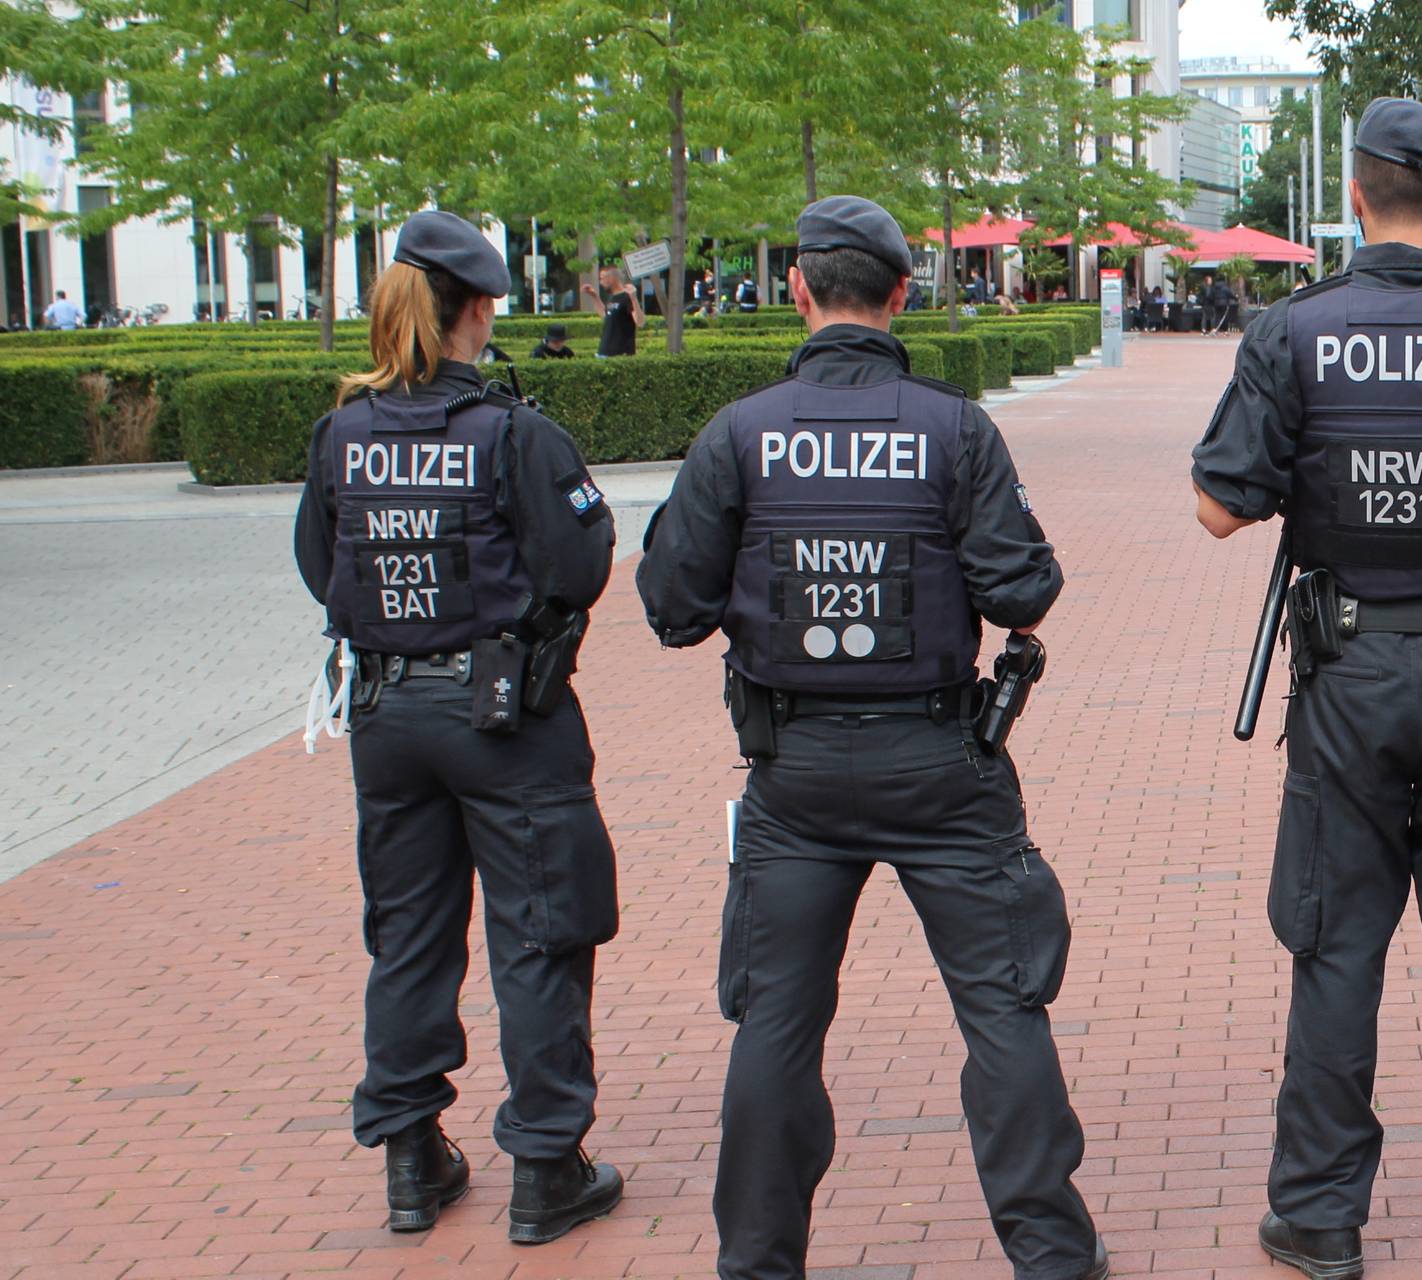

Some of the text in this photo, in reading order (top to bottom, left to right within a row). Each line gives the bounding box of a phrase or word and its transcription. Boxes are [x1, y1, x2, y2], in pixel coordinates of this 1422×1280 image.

[345, 442, 476, 487] POLIZEI
[761, 430, 928, 480] POLIZEI
[366, 508, 440, 540] NRW
[374, 553, 437, 586] 1231
[795, 538, 886, 574] NRW
[380, 587, 440, 619] BAT
[804, 583, 880, 618] 1231
